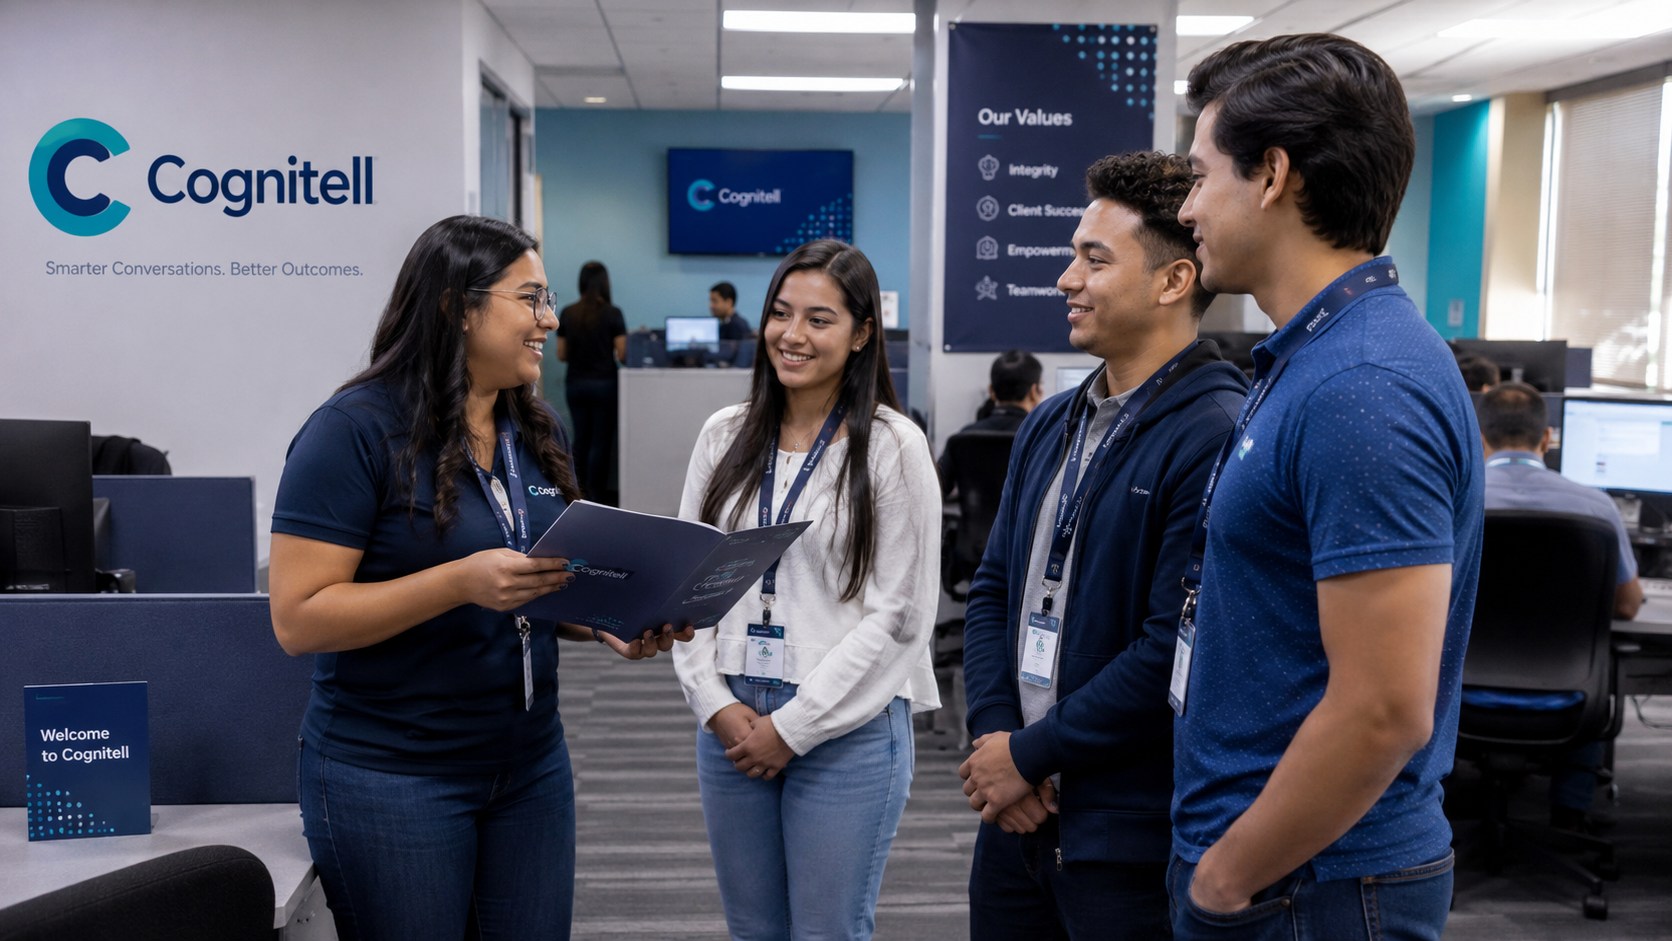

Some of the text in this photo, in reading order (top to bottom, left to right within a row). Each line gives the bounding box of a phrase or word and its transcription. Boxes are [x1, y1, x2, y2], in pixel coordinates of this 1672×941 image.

[978, 108, 1073, 127] Our Values
[1008, 164, 1059, 179] Integrity
[147, 154, 373, 218] Cognitell
[718, 188, 782, 207] Cognitell
[1007, 203, 1086, 217] Client Succes
[1007, 243, 1076, 258] Empowerm
[45, 261, 364, 277] Smarter Conversations. Better Outcomes.
[40, 728, 110, 742] Welcome
[41, 745, 130, 764] to Cognitell
